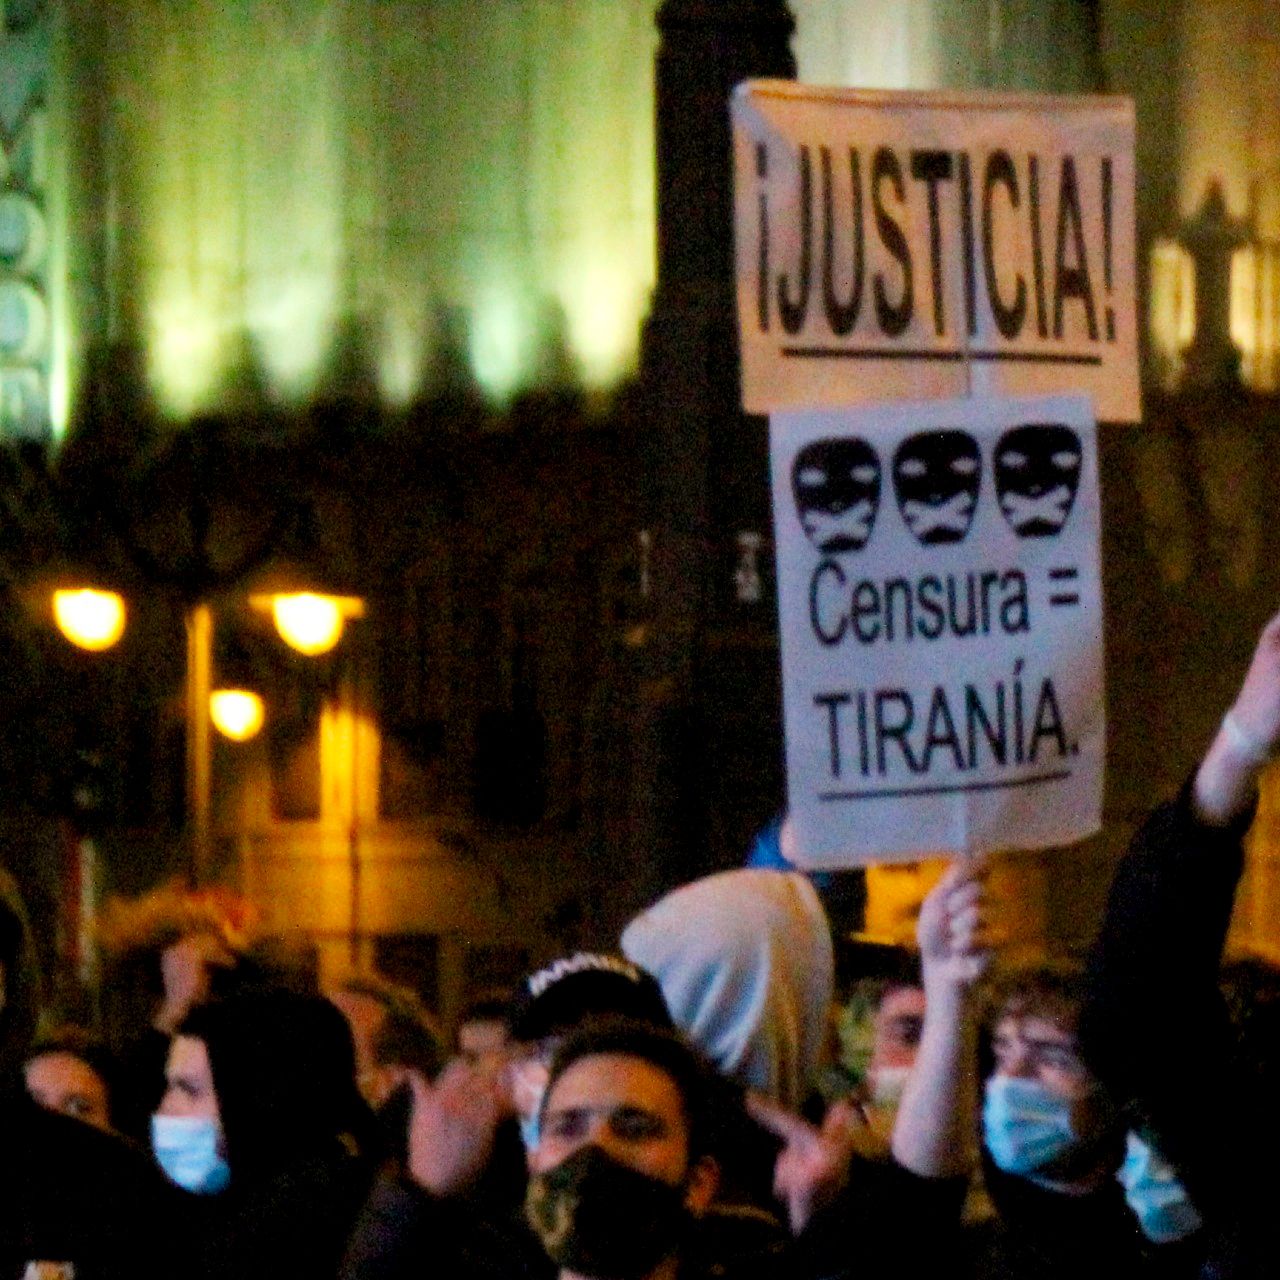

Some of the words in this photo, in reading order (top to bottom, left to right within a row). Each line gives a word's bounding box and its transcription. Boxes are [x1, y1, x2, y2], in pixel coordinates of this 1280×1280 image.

[756, 142, 1117, 343] ¡JUSTICIA!
[809, 560, 1031, 647] Censura
[813, 660, 1080, 779] TIRANÍA.
